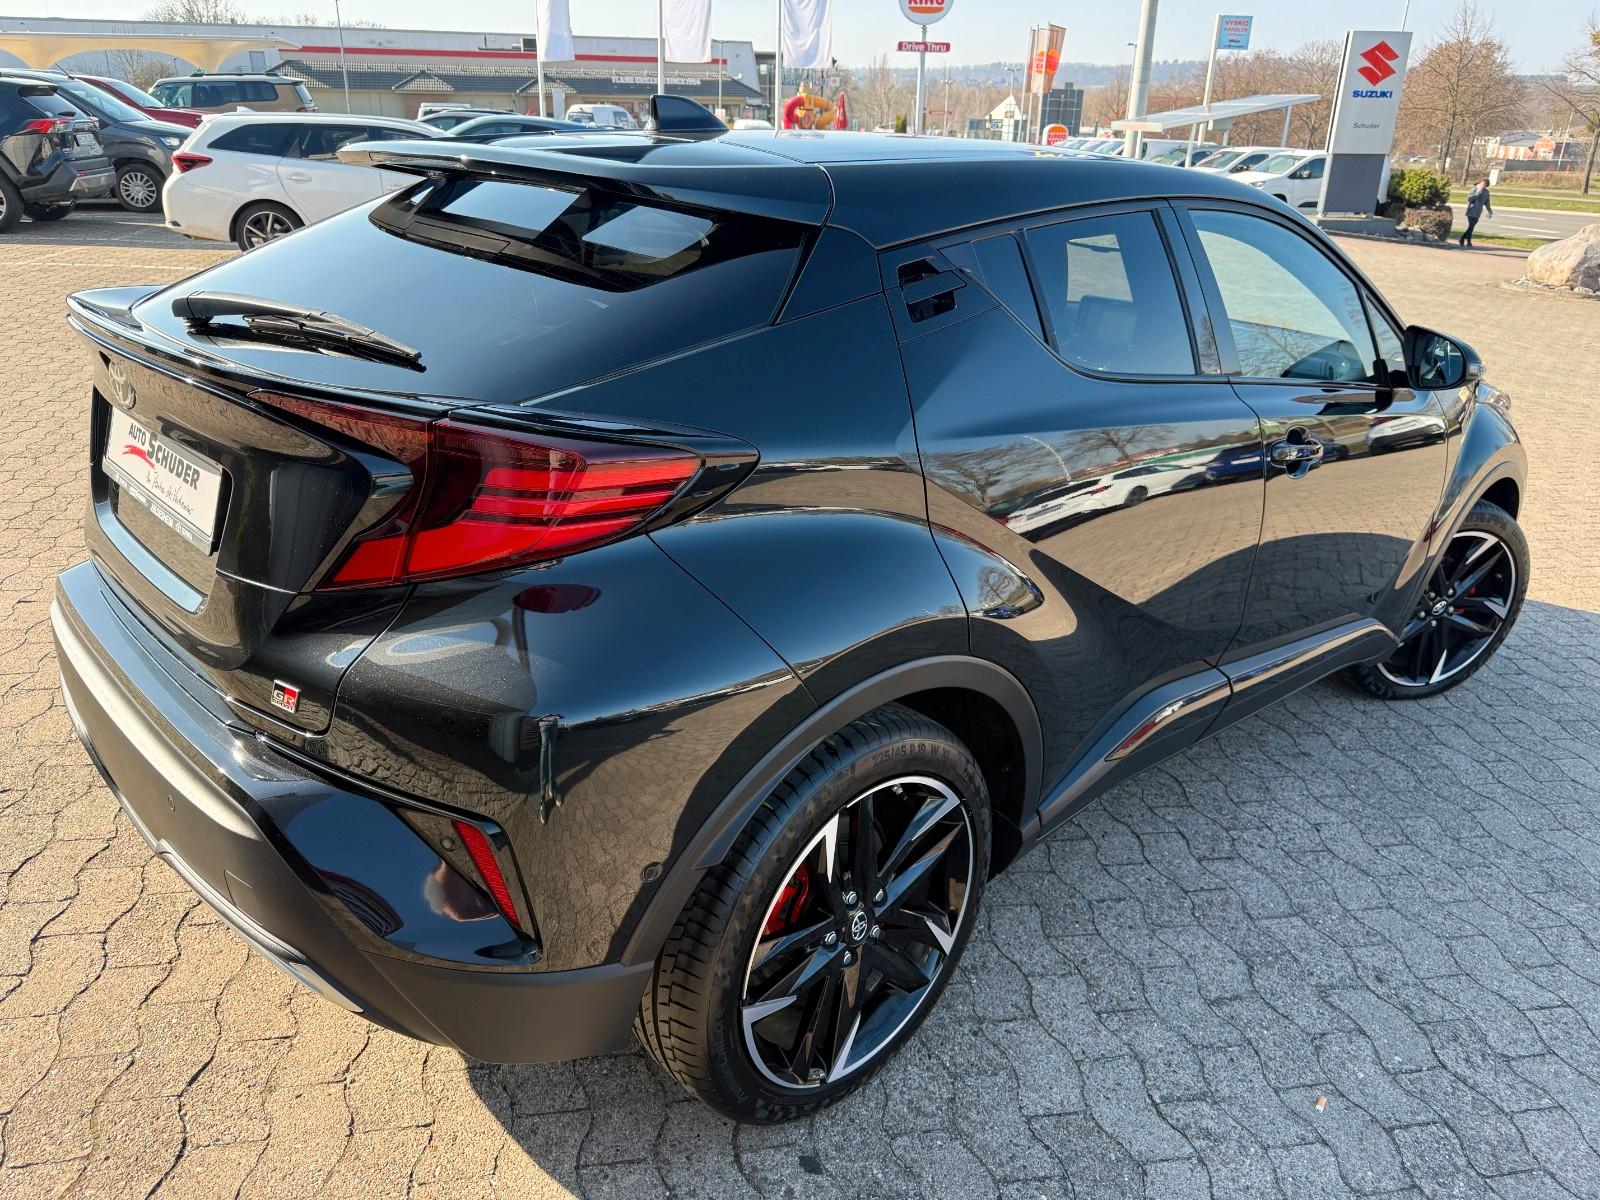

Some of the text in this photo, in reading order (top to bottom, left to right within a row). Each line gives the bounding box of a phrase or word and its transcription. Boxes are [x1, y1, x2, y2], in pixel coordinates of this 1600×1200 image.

[902, 42, 947, 52] Drive Thru
[1352, 90, 1393, 99] SUZUKI
[128, 423, 147, 446] AUTO
[147, 431, 201, 491] SCHUDER
[273, 690, 295, 706] GR
